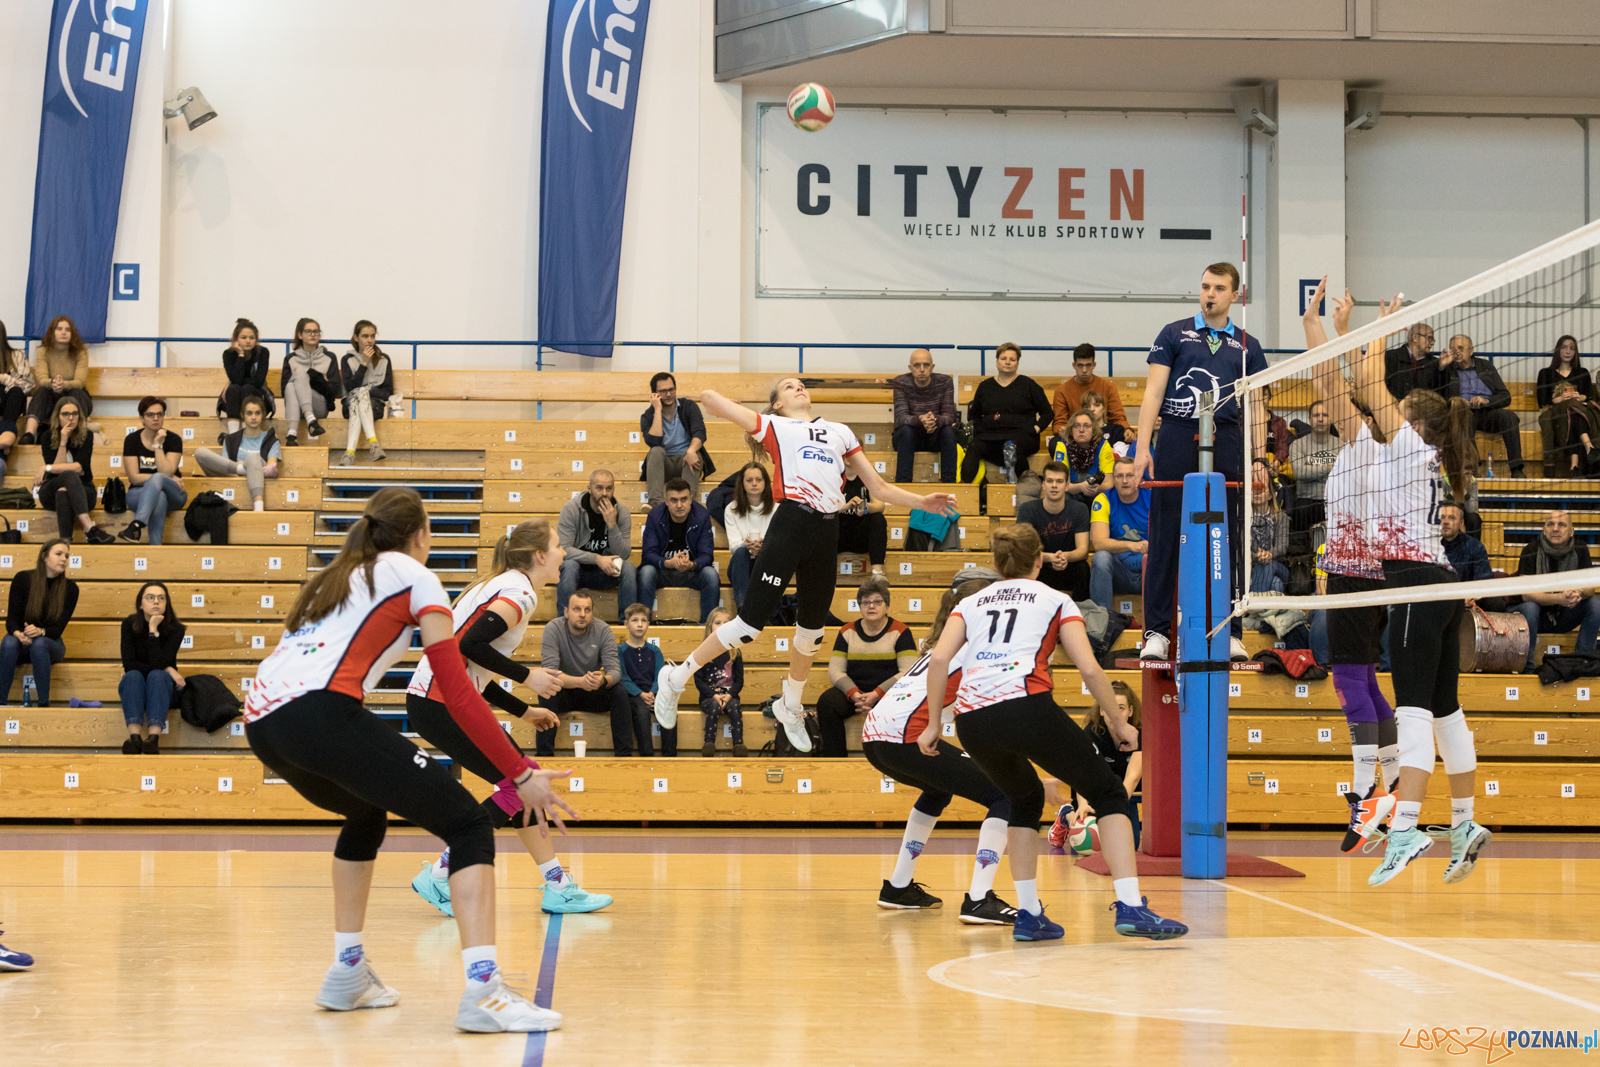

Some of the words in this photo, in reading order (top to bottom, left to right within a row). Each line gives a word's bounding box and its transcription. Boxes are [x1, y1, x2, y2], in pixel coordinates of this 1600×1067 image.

[797, 163, 1144, 221] CITYZEN
[904, 223, 961, 239] WIĘCEJ
[970, 223, 996, 238] NIŻ
[1005, 225, 1047, 238] KLUB
[1056, 225, 1146, 240] SPORTOWY
[118, 269, 134, 295] C
[809, 428, 828, 444] 12
[802, 450, 834, 464] Enea
[1211, 539, 1222, 580] Senoh
[761, 572, 782, 587] MB
[996, 587, 1021, 595] ENEA
[976, 593, 1037, 607] ENERGETYK
[1145, 661, 1171, 669] Senoh
[1321, 730, 1329, 738] 13
[1340, 784, 1348, 792] 13
